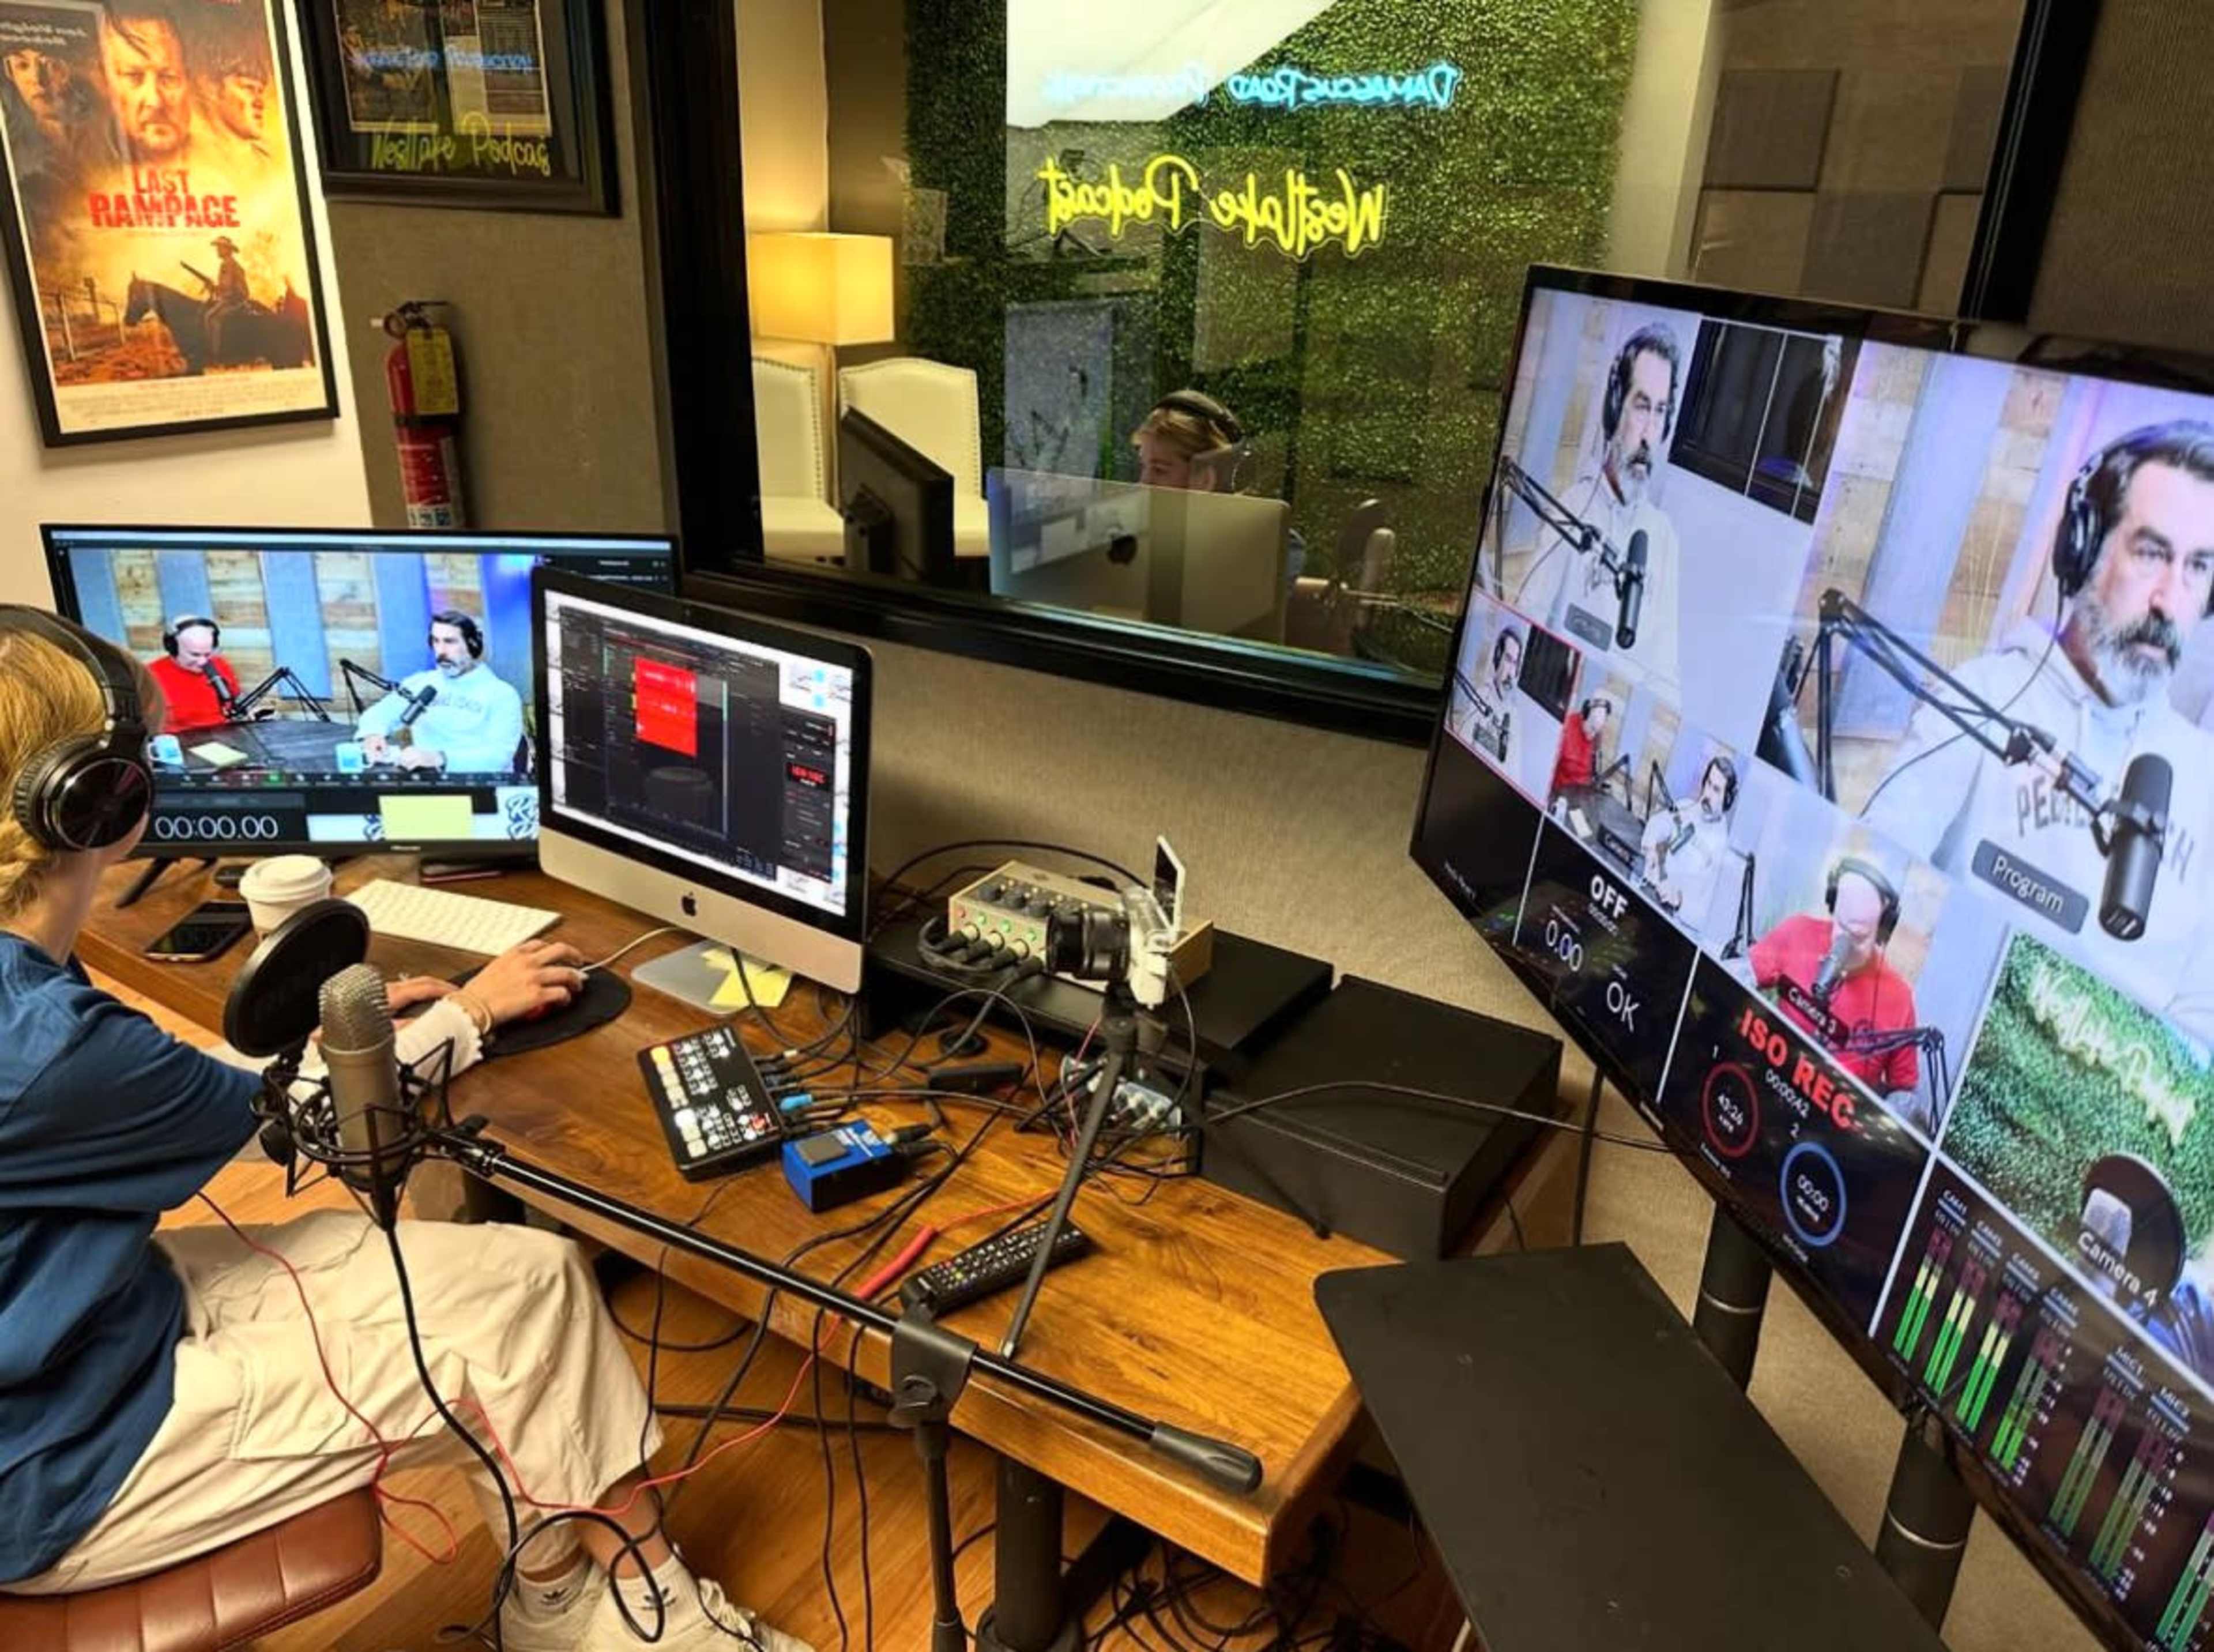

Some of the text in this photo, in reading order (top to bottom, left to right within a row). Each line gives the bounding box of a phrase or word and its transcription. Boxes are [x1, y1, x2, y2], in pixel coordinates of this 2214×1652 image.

[132, 165, 191, 194] LAST
[89, 191, 241, 228] RAMPAGE
[1591, 874, 1629, 919] OFF
[1992, 854, 2065, 913] Program
[1606, 981, 1640, 1033] OK
[1788, 986, 1827, 1026] Camera
[1739, 1008, 1855, 1129] ISO REC
[2077, 1231, 2141, 1295] Camera
[2143, 1288, 2159, 1307] 4
